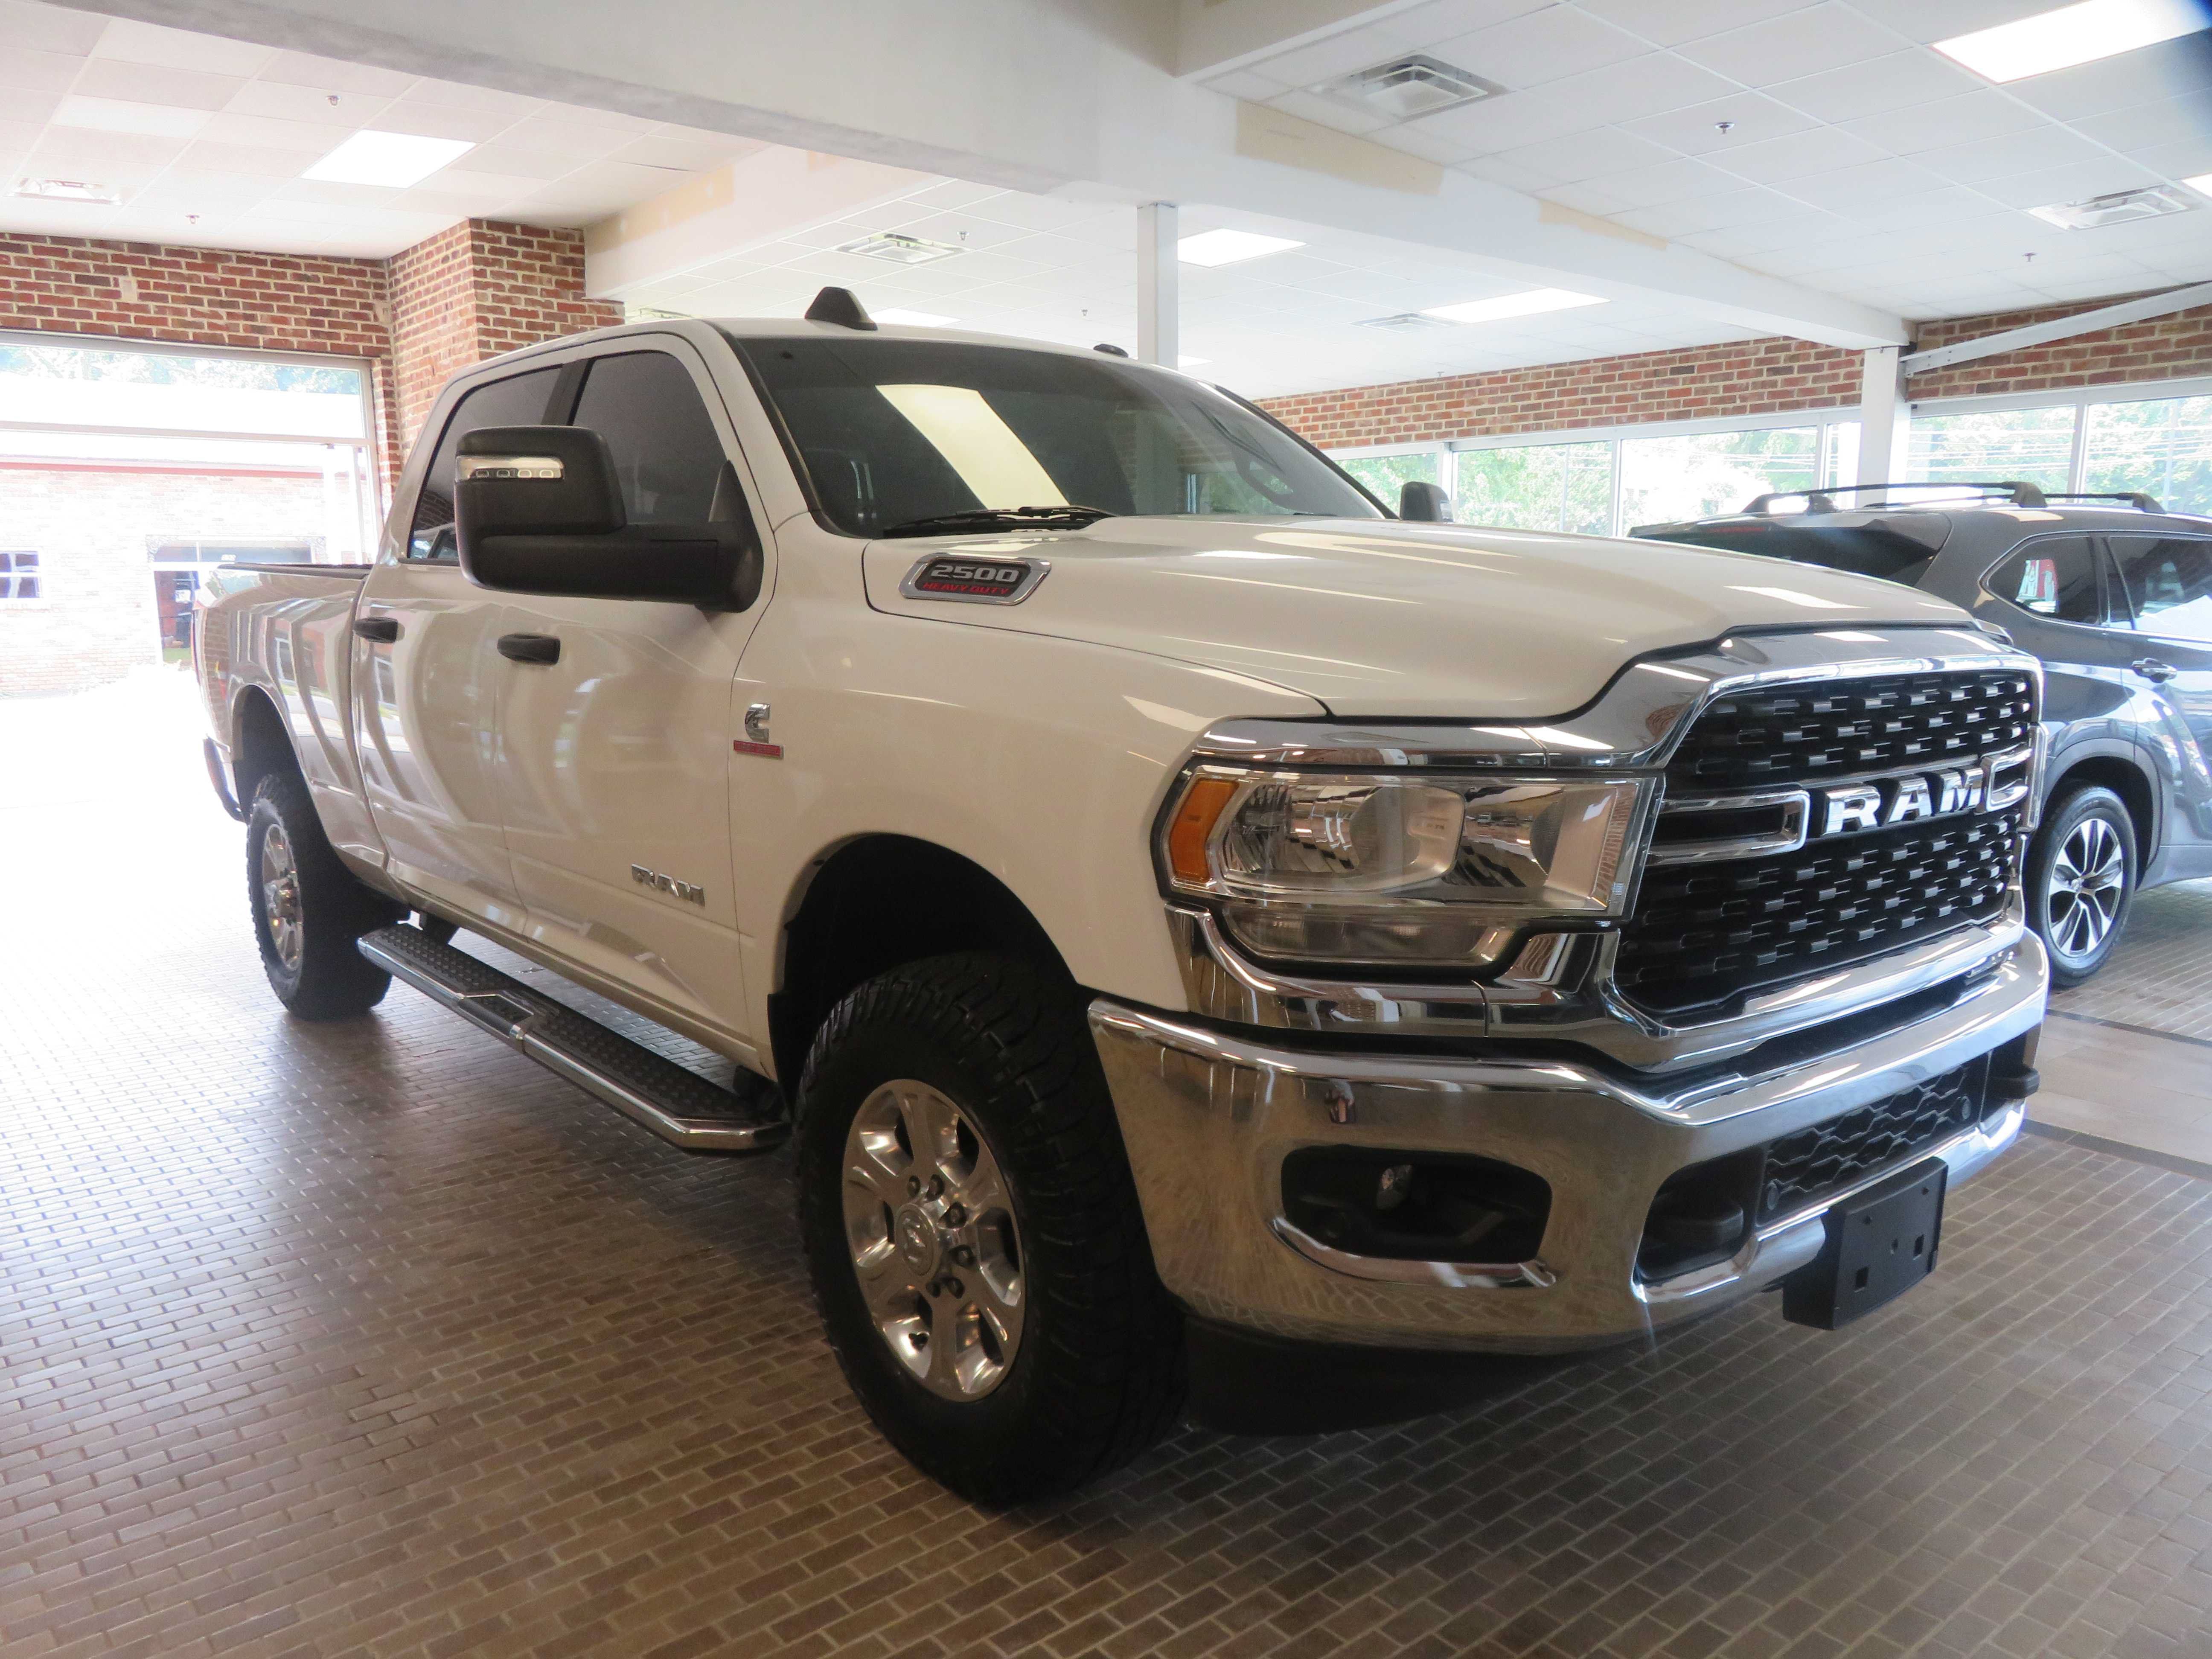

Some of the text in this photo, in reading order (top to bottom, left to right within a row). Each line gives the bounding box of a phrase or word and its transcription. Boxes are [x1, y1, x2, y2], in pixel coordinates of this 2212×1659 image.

[923, 582, 1009, 594] HEAVY DUTY
[931, 565, 1019, 582] 2500
[1822, 768, 1984, 836] RAM
[631, 864, 705, 907] RAM
